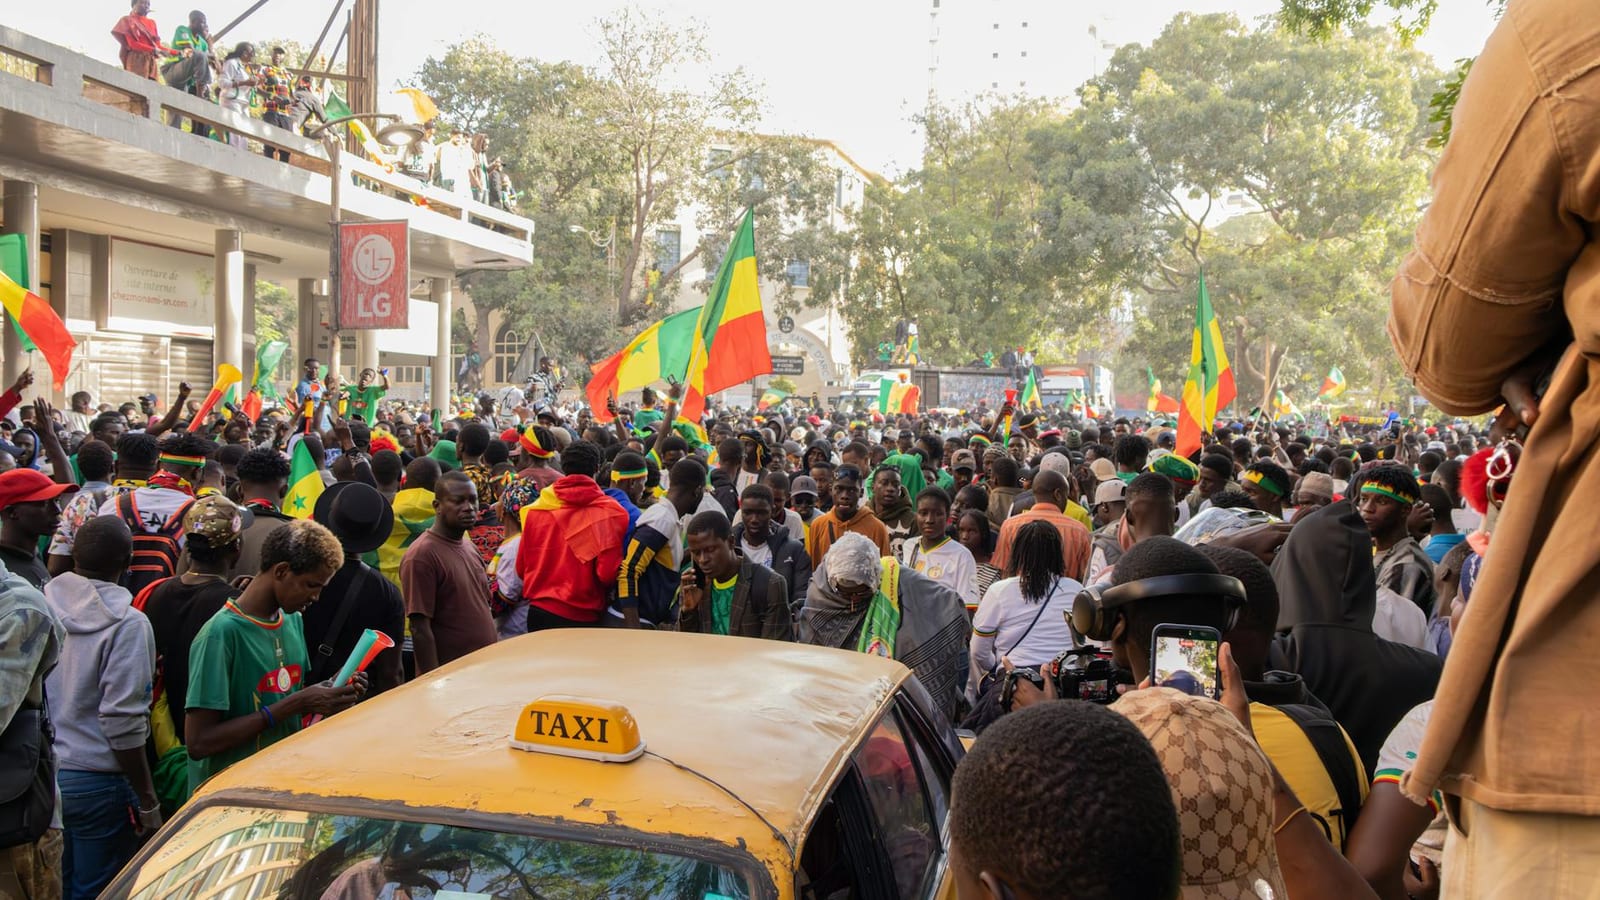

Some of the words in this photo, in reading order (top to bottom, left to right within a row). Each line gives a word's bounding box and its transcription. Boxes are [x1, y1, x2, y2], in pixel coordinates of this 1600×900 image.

[124, 264, 168, 279] Ouverture
[168, 270, 178, 281] de
[143, 283, 176, 293] internet
[357, 292, 392, 318] LG
[530, 710, 609, 743] TAXI
